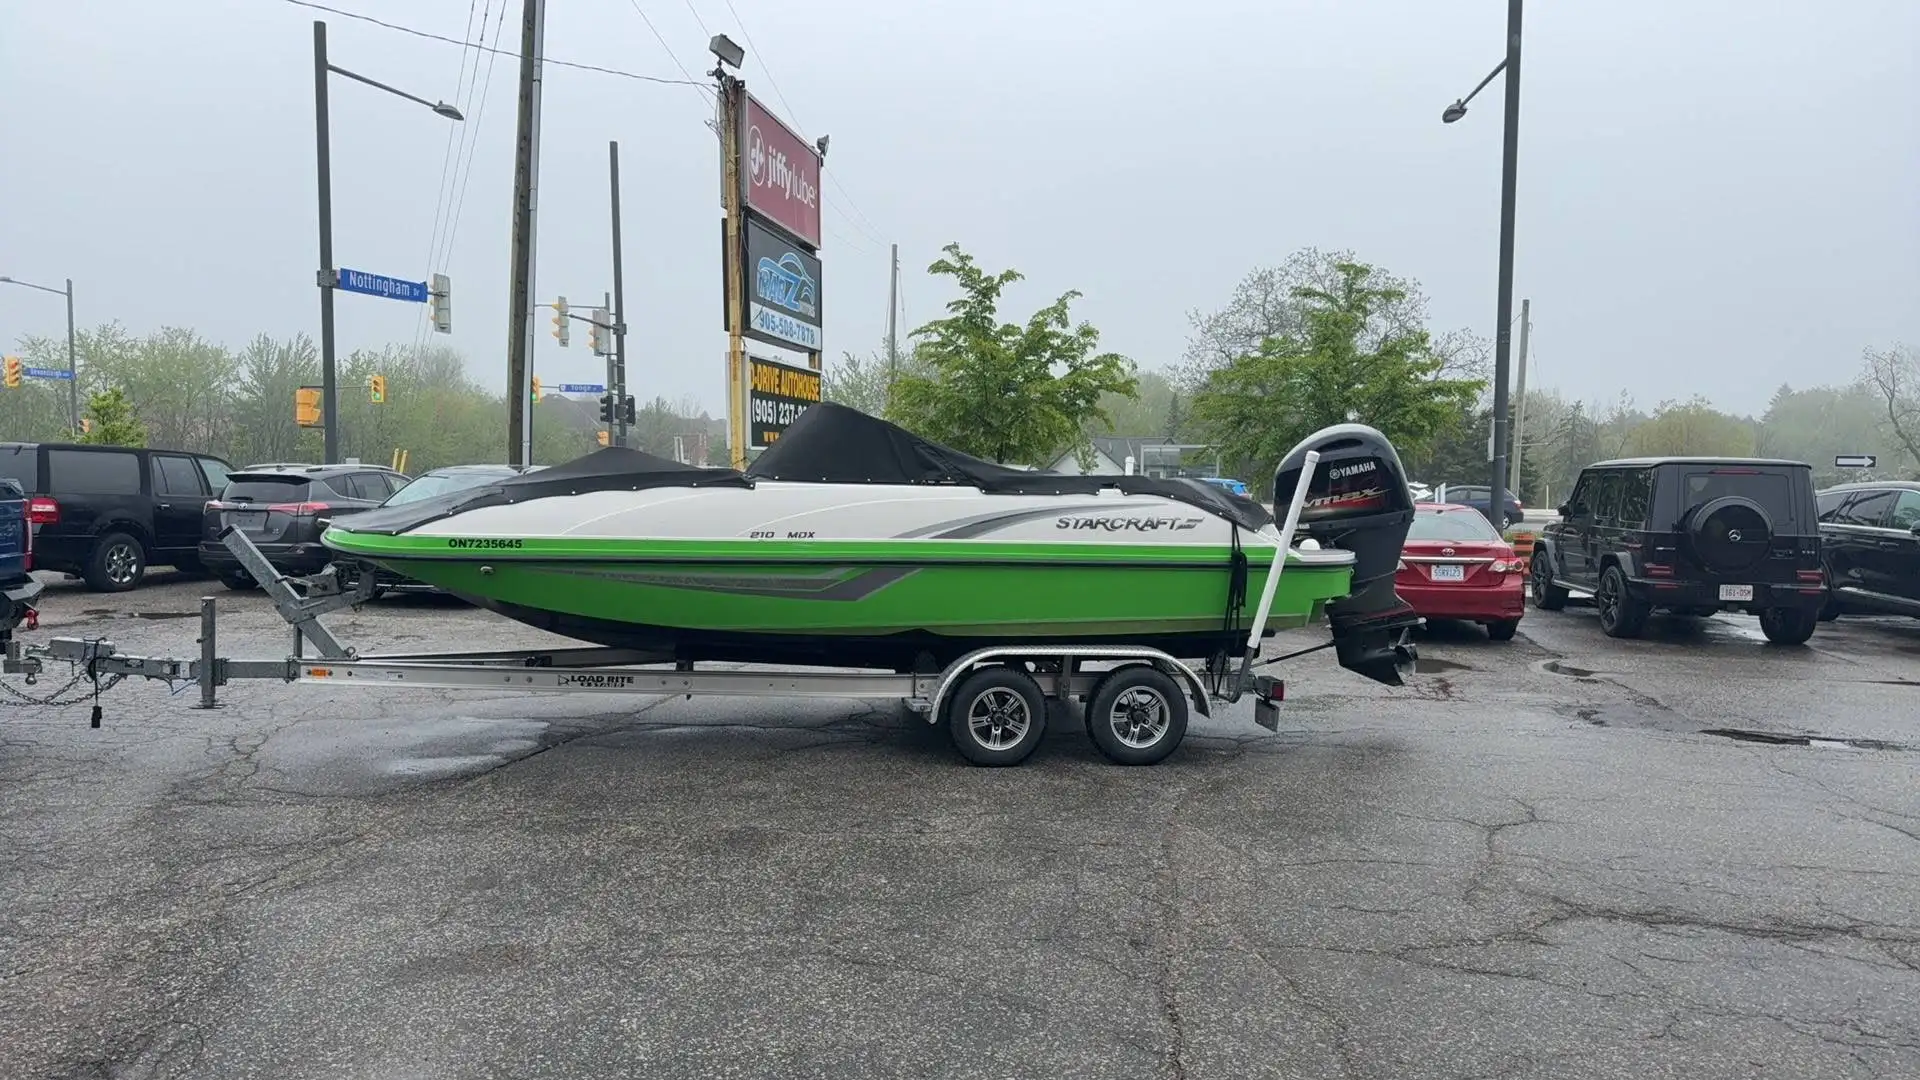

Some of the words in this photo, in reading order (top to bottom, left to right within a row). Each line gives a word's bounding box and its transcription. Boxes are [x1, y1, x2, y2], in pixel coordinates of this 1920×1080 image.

[349, 271, 410, 296] Nottingham
[760, 311, 815, 345] 905-508-7878
[780, 368, 820, 401] AUTOHOUSE
[752, 398, 777, 425] (905)
[1339, 461, 1376, 477] YAMAHA
[1056, 517, 1182, 532] STARCRAFT
[448, 538, 523, 549] ON7235645
[570, 675, 605, 684] LOAD
[607, 675, 635, 685] RITE
